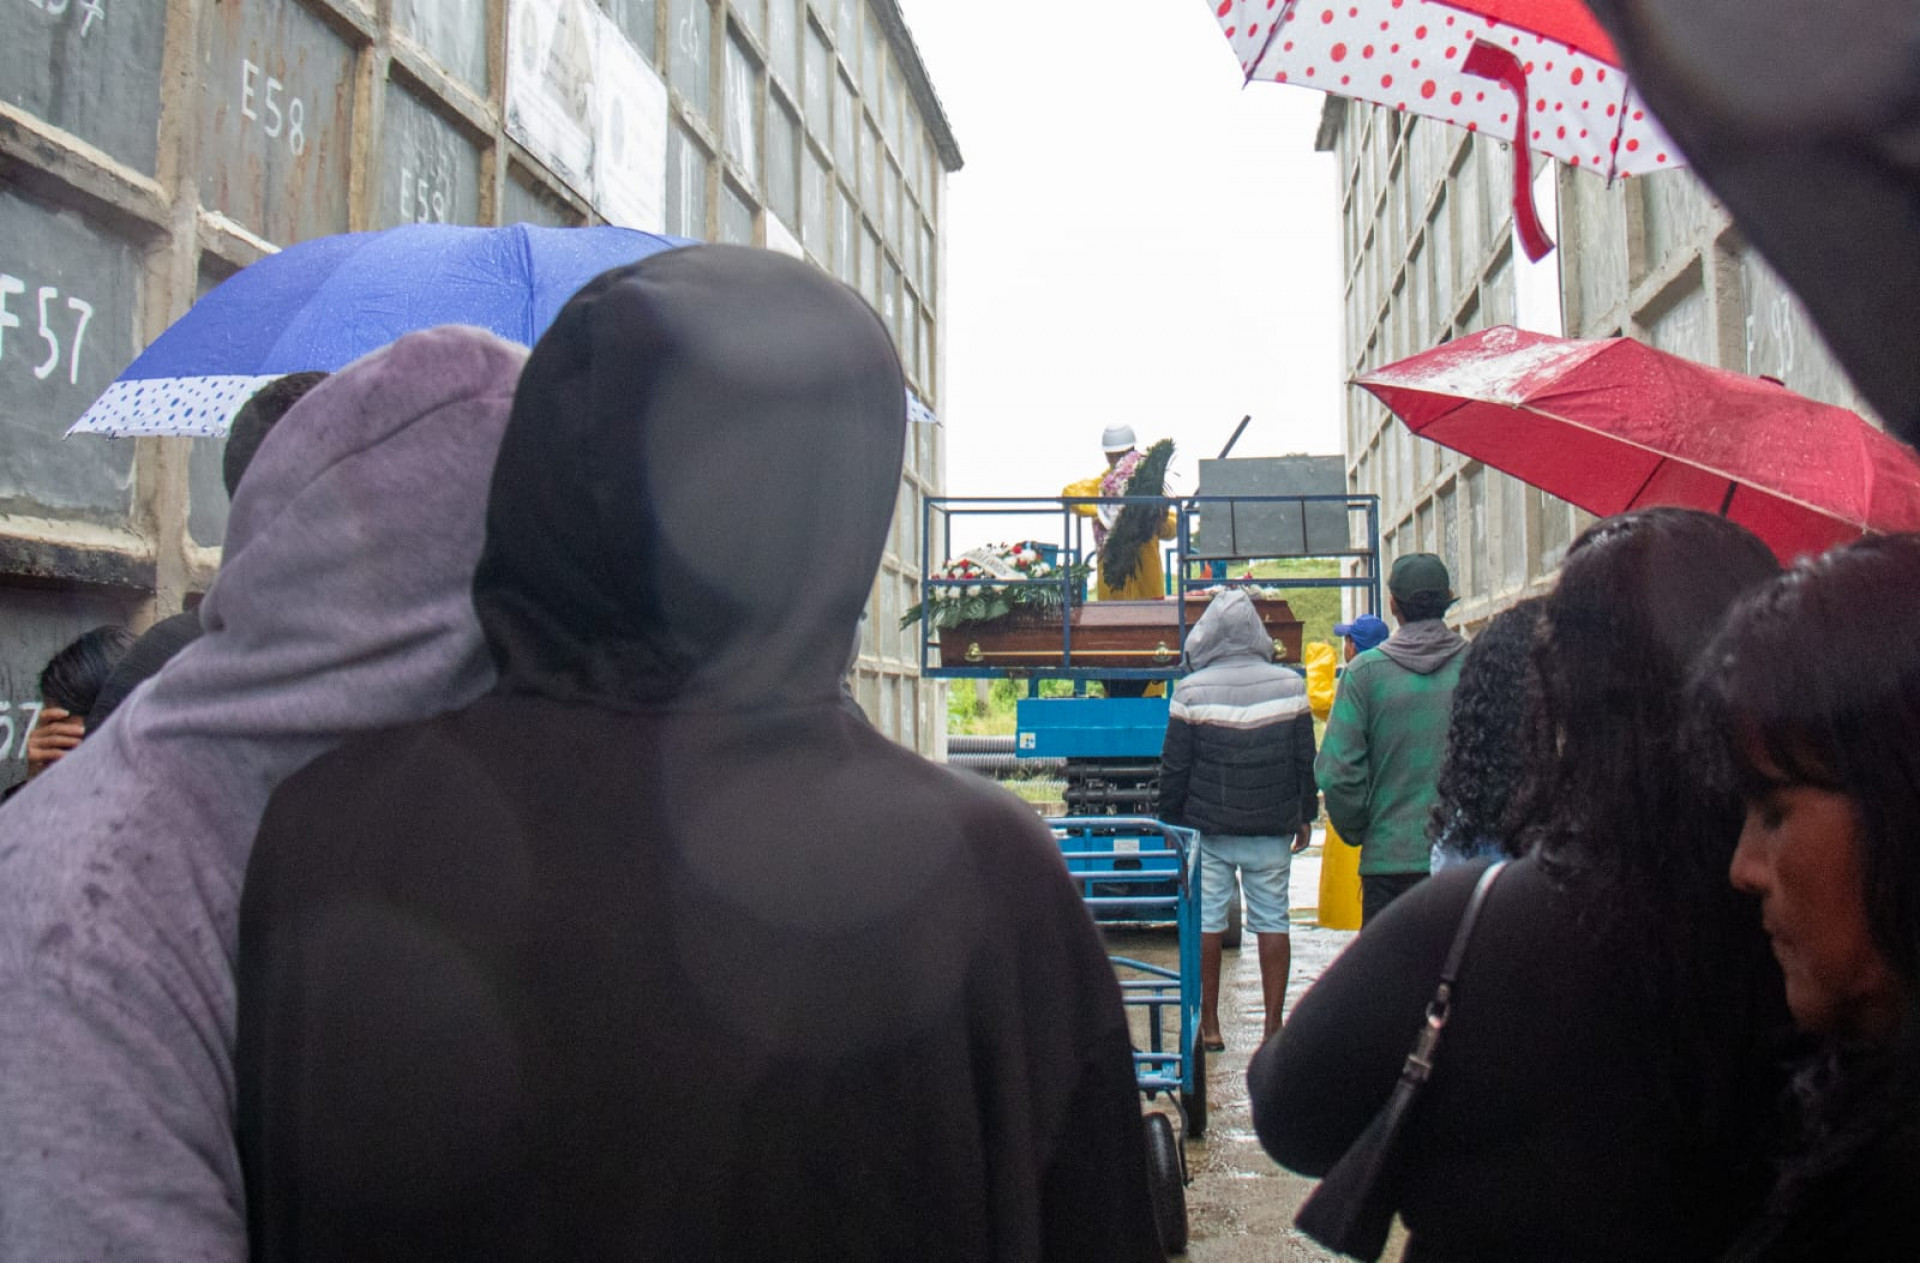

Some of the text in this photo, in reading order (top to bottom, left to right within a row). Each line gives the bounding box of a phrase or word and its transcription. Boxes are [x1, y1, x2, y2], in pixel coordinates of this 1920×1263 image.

[240, 59, 304, 157] E58
[401, 167, 445, 224] E59
[0, 273, 93, 385] F57
